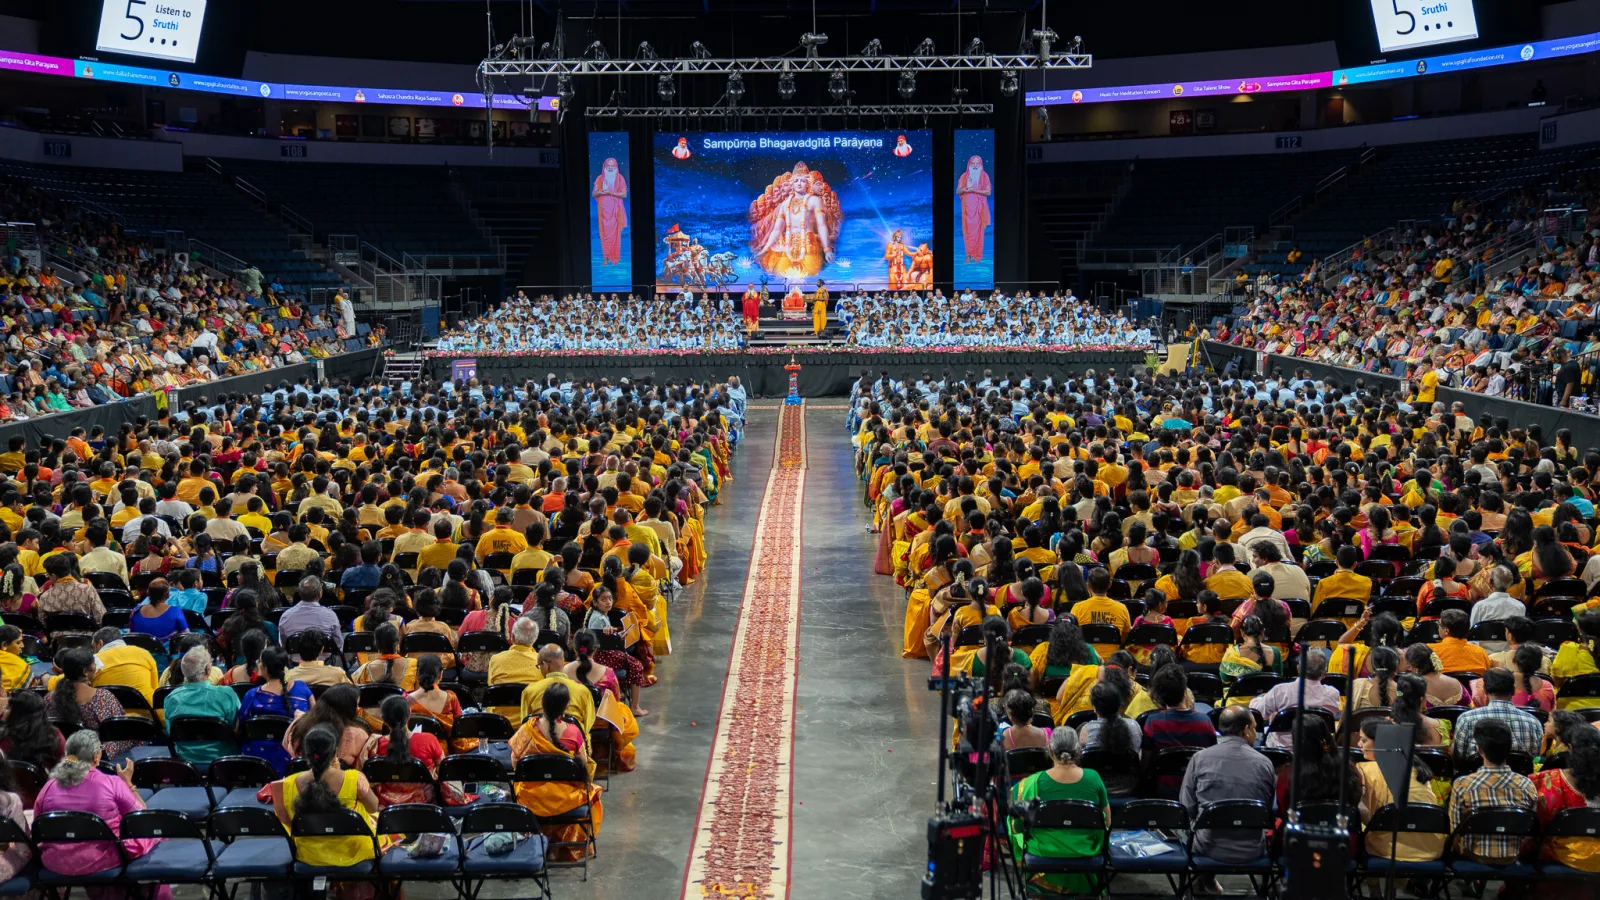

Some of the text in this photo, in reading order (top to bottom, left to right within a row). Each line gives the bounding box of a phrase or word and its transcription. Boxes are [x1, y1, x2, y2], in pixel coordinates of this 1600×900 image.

[155, 4, 192, 18] Listen to
[1421, 2, 1448, 16] Sruthi
[152, 18, 179, 31] Sruthi
